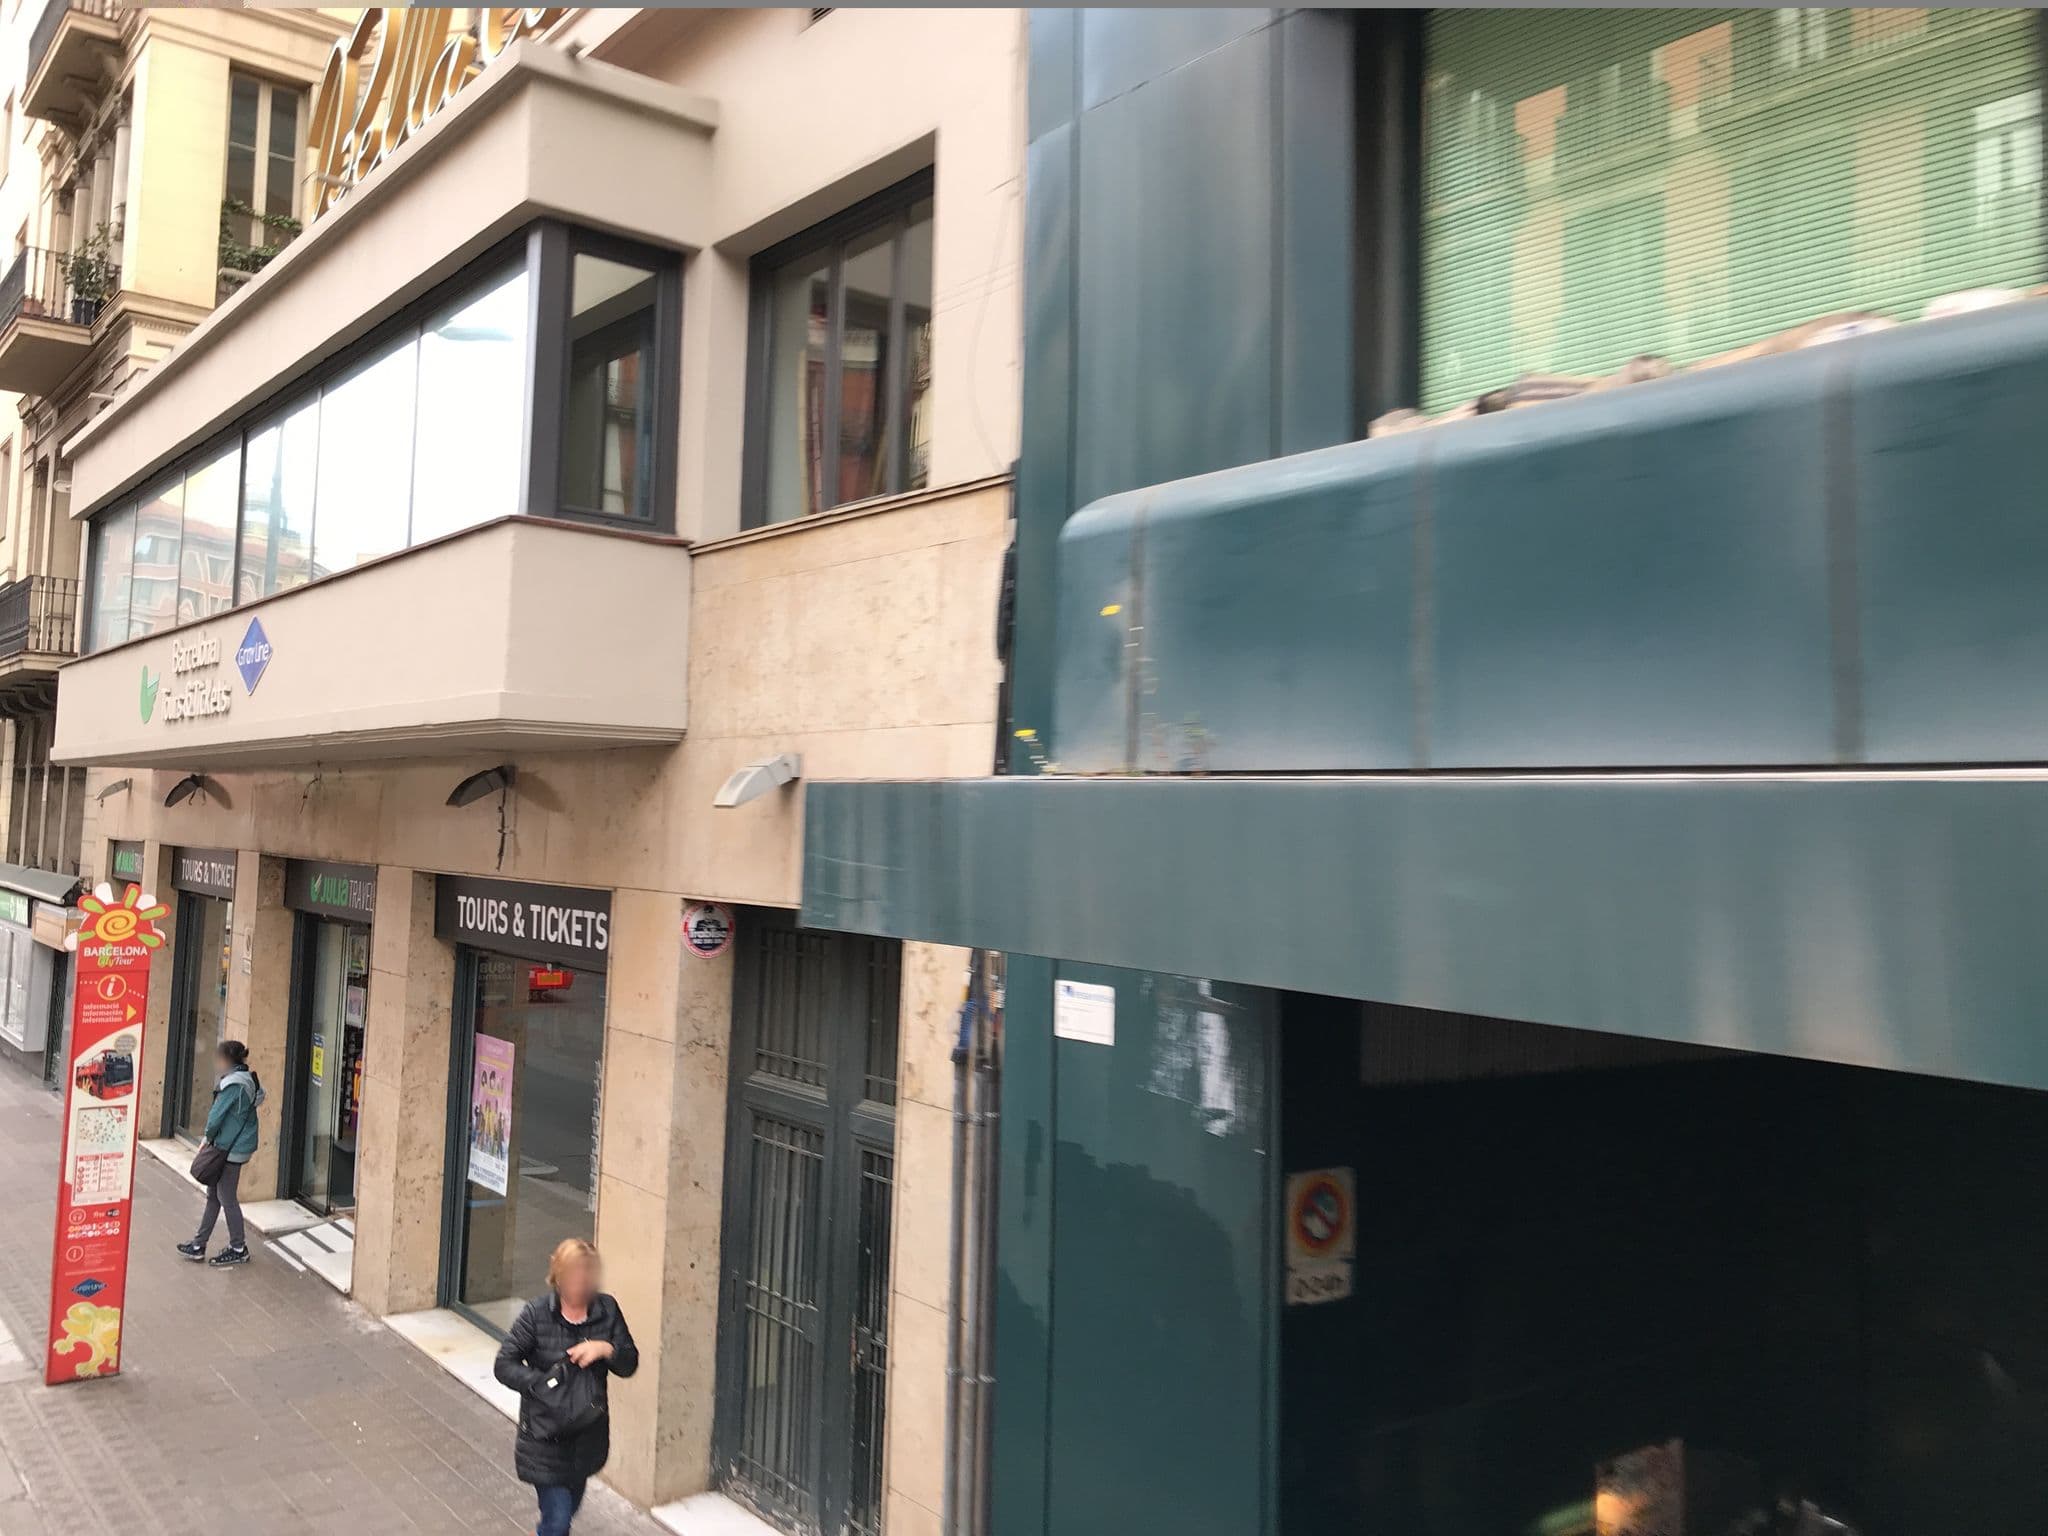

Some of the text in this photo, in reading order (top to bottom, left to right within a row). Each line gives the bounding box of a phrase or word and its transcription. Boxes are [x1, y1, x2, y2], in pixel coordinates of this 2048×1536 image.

[182, 858, 203, 883] TOURS
[203, 860, 209, 884] &
[457, 895, 608, 950] TOURS & TICKETS
[84, 946, 148, 957] BARCELONA
